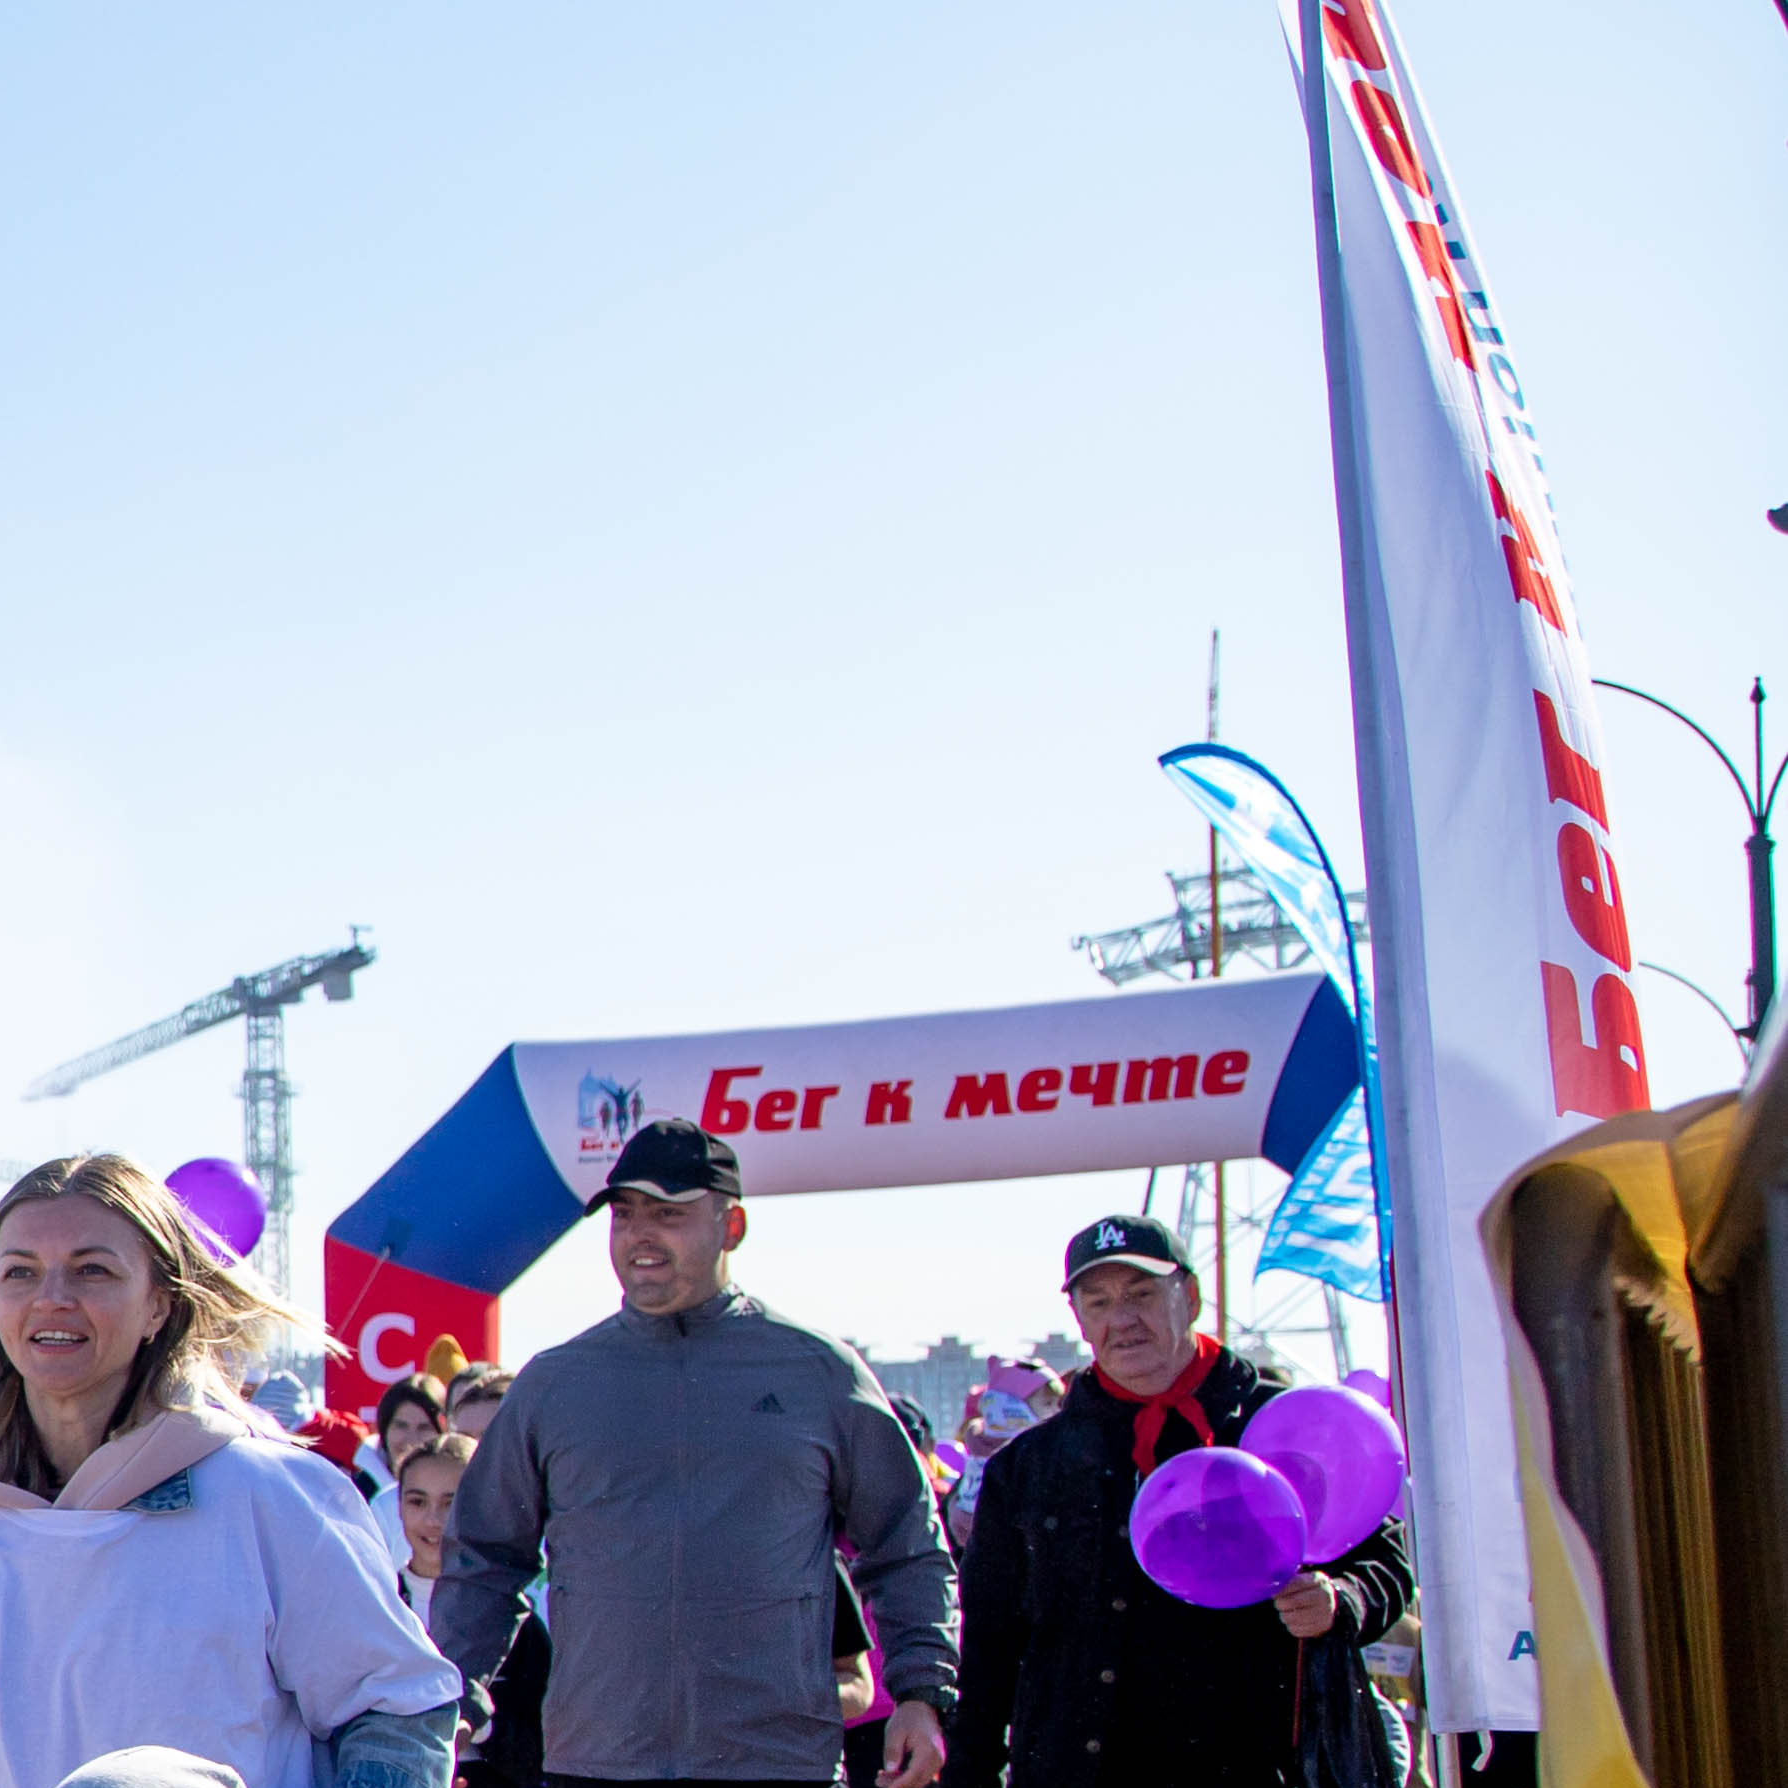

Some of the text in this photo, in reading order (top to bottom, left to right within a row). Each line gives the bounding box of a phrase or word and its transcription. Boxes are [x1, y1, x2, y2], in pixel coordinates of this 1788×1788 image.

[699, 1049, 1251, 1136] Бег к мечте
